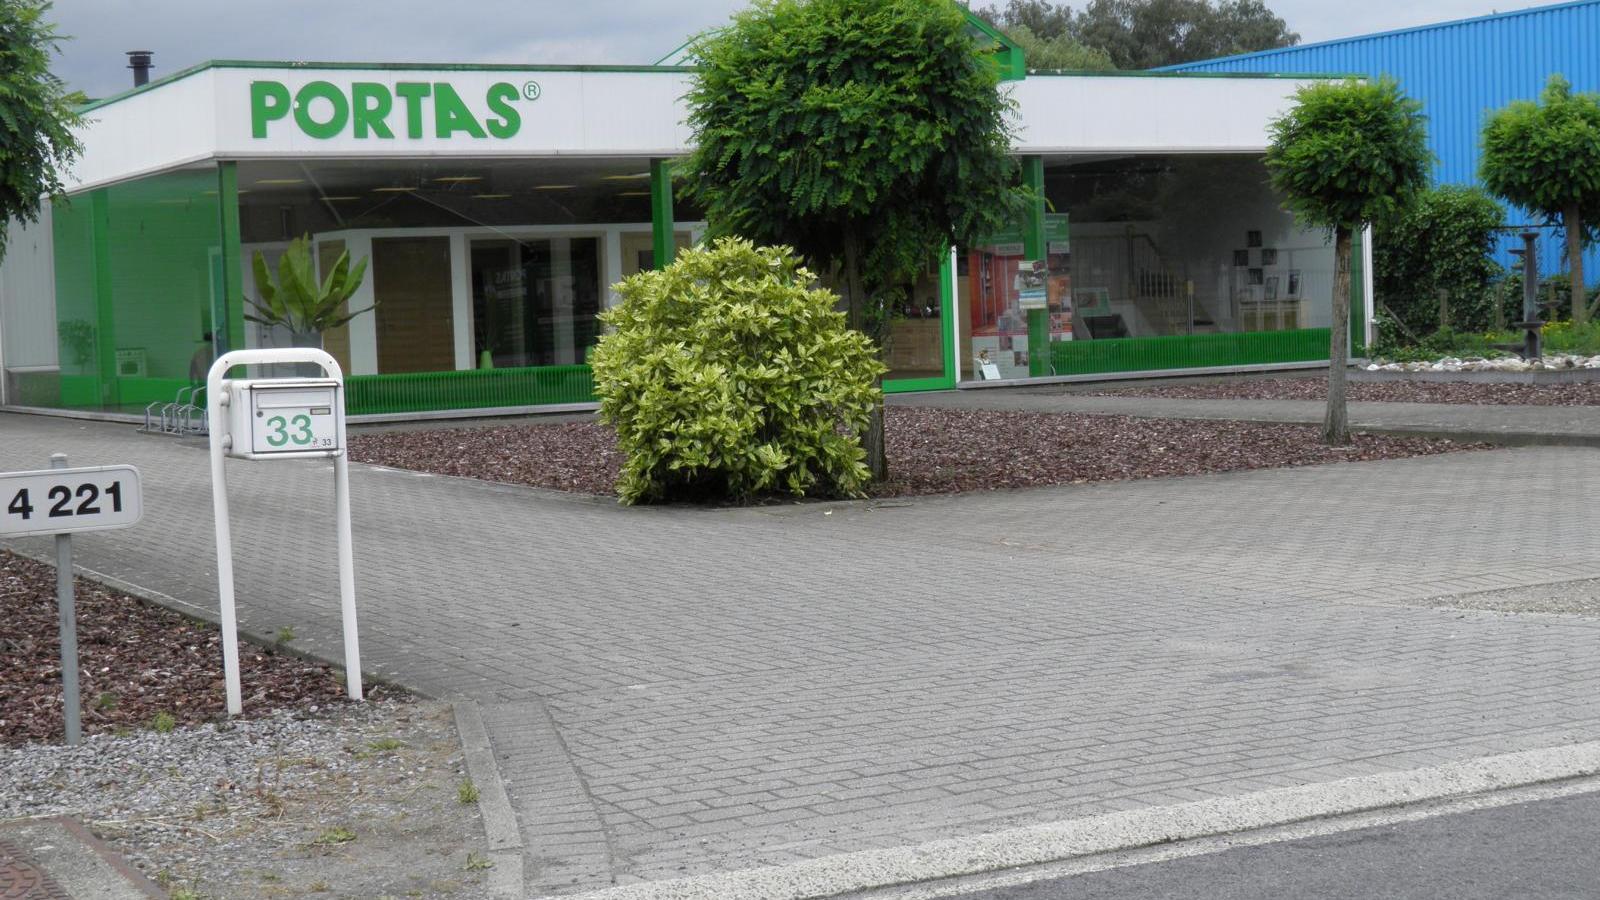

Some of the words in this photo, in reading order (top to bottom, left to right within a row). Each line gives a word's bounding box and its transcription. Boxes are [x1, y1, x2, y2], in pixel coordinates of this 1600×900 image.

[251, 80, 521, 139] PORTAS
[266, 415, 313, 446] 33
[8, 488, 34, 519] 4
[48, 481, 122, 517] 221
